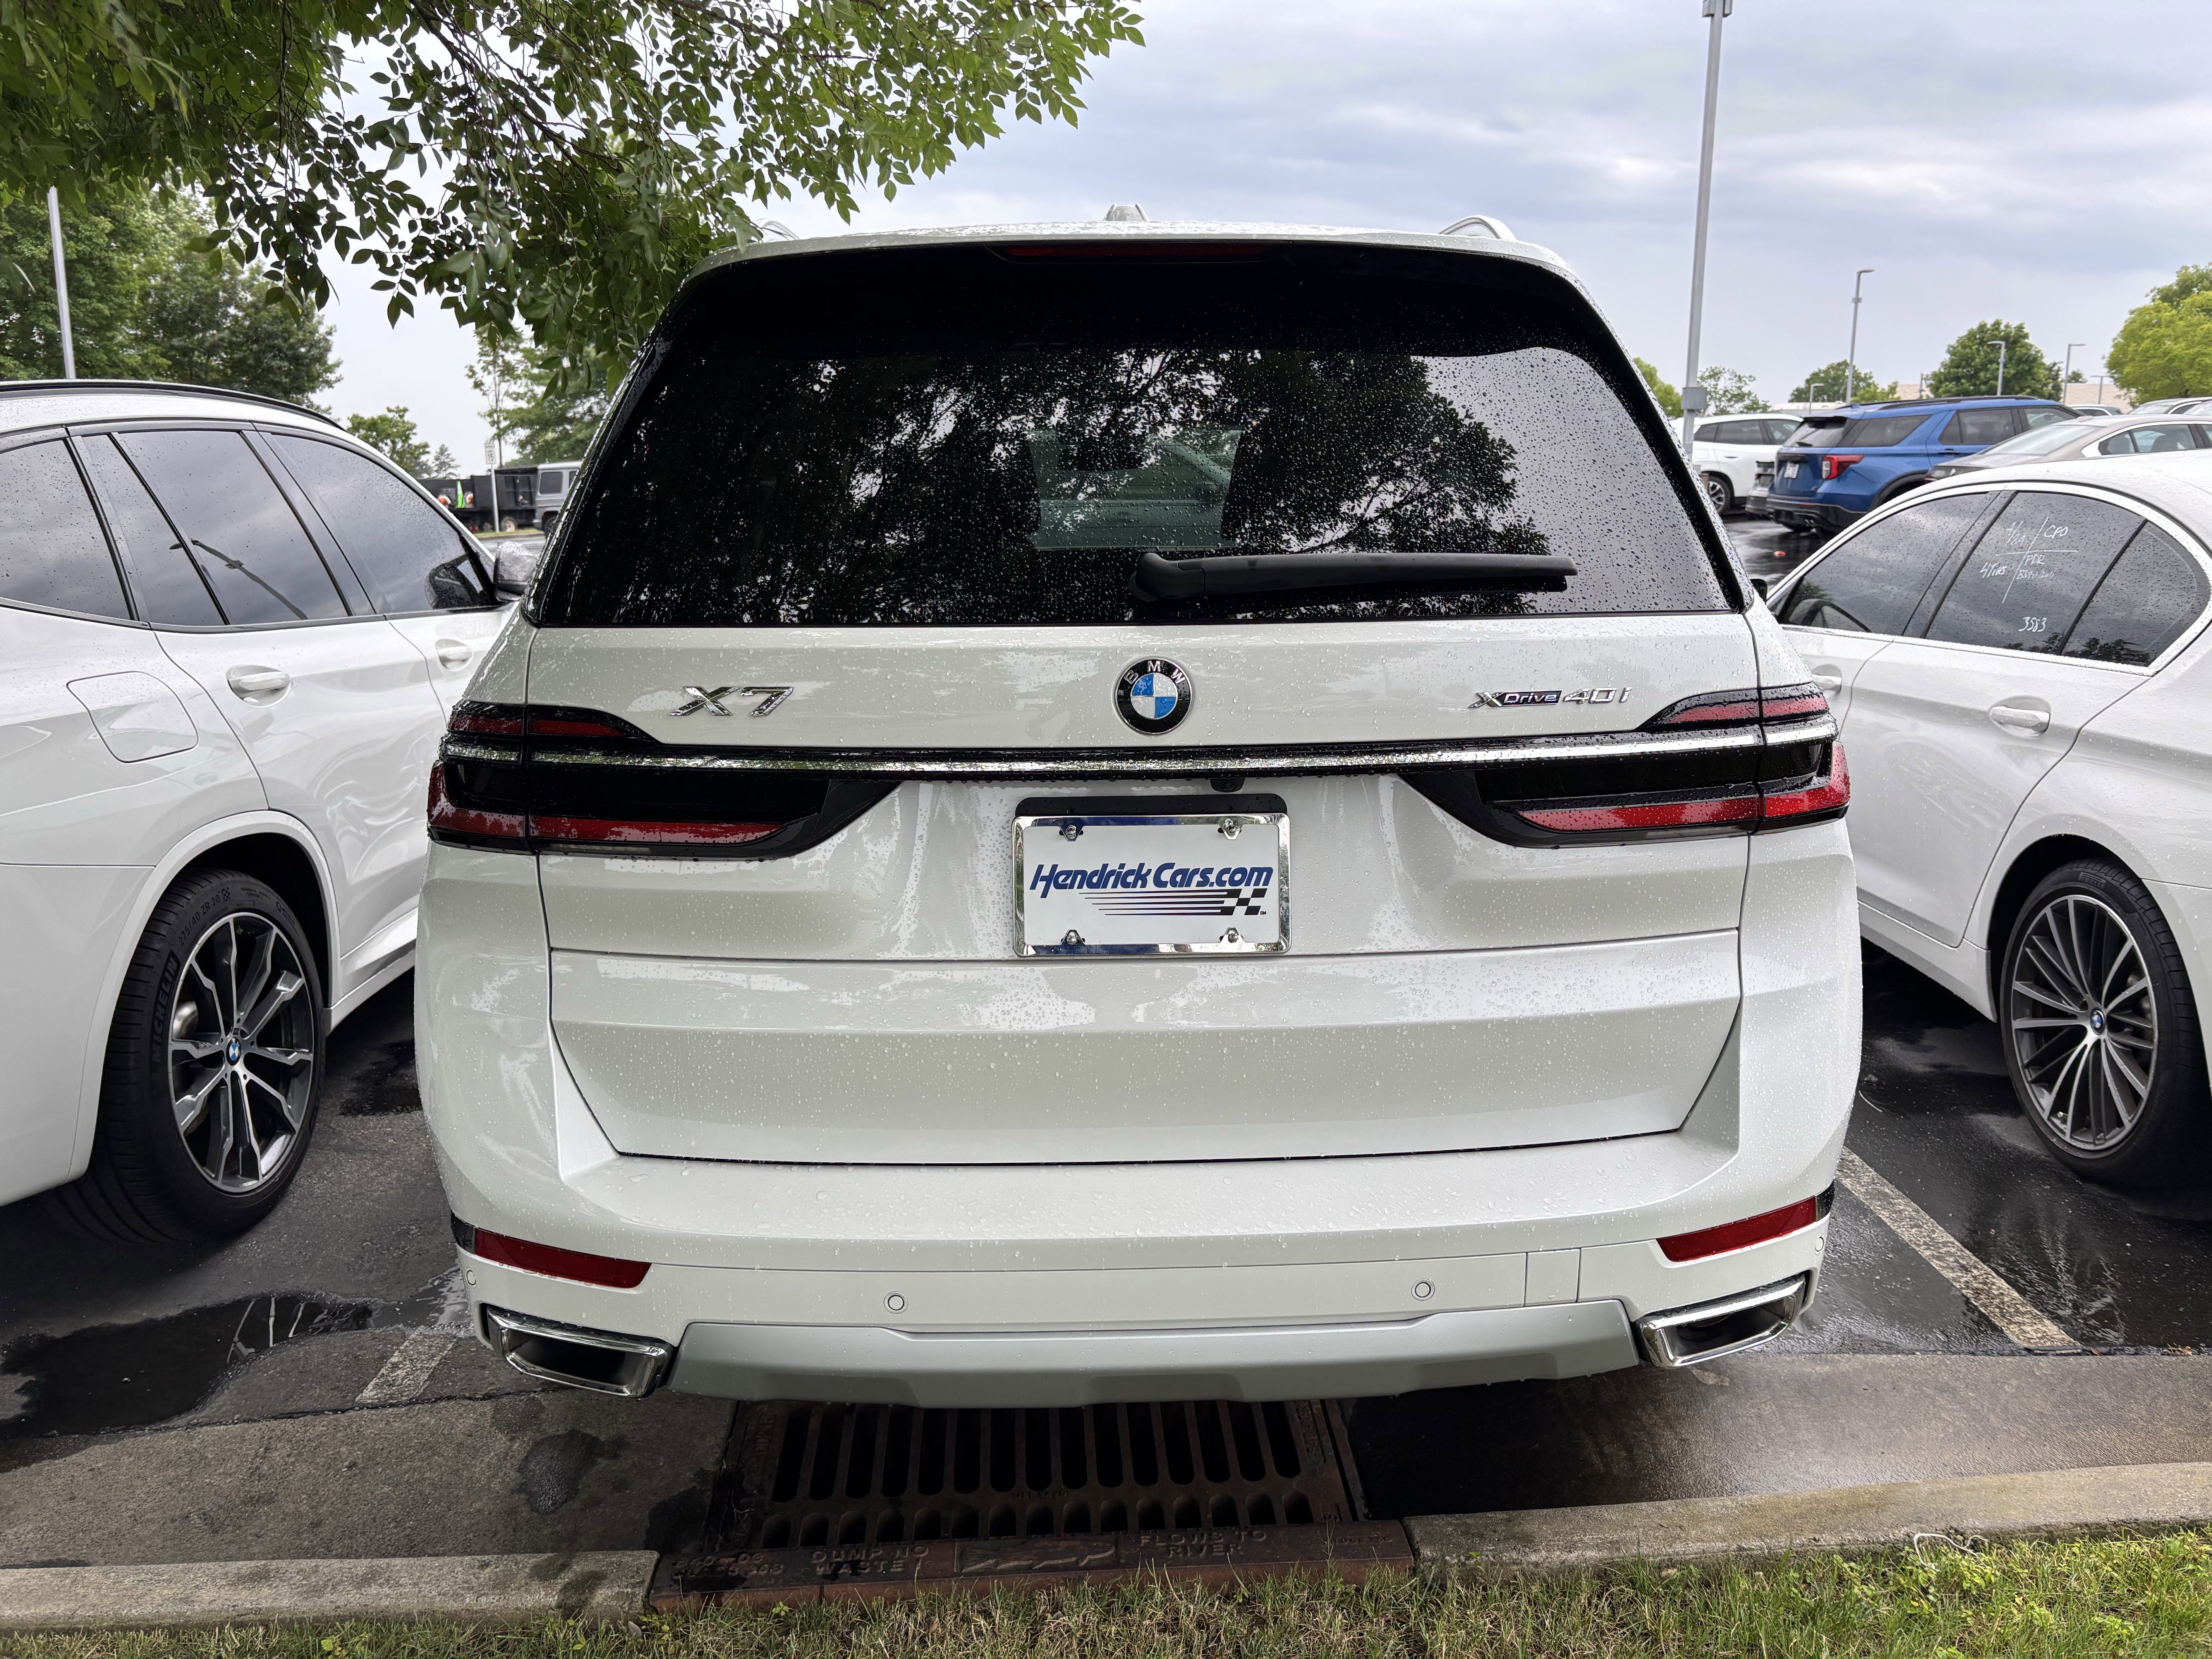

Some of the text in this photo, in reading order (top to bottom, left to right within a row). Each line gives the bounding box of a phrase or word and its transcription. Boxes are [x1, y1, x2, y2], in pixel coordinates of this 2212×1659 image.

[2044, 525, 2068, 539] CPO
[2018, 617, 2047, 632] 3583
[1124, 660, 1186, 685] BMW
[668, 686, 794, 716] X7
[179, 911, 200, 947] 275/40
[152, 957, 178, 1064] MICHELIN
[1139, 1530, 1267, 1546] FLOWS TO
[811, 1546, 929, 1564] DUMP NO
[1167, 1544, 1245, 1559] RIVER
[816, 1559, 908, 1575] WASTE
